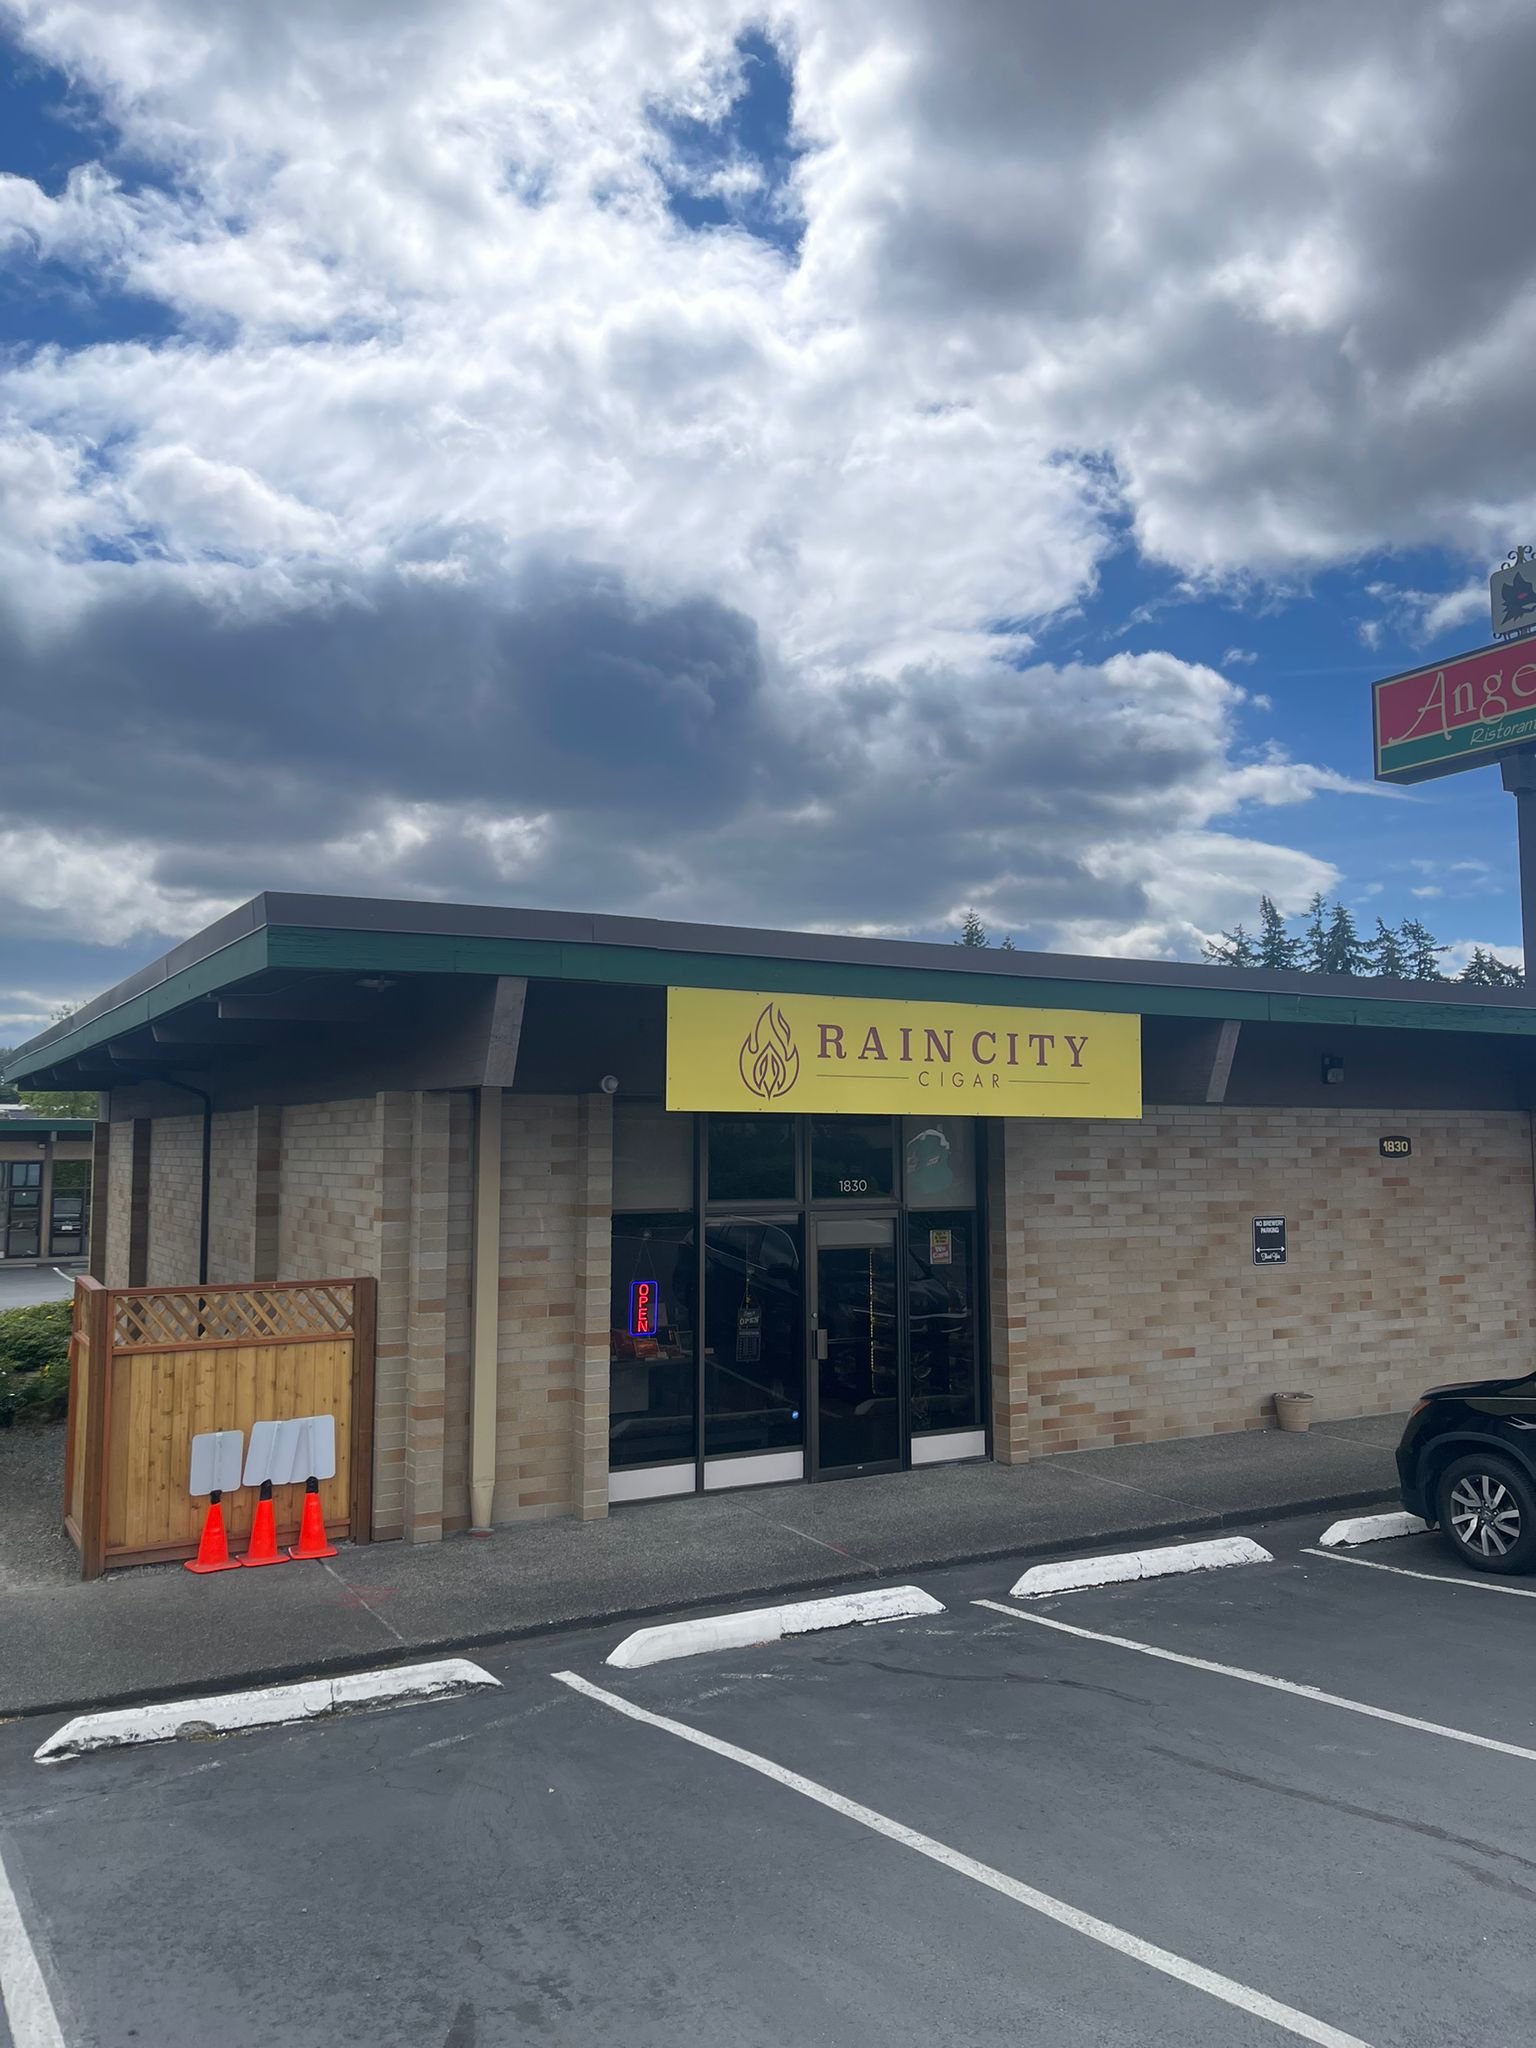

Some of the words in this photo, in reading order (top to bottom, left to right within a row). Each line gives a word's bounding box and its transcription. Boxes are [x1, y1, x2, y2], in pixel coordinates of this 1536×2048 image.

[817, 1024, 955, 1063] RAIN
[971, 1031, 1088, 1067] CITY
[918, 1071, 1001, 1089] CIGAR
[1383, 1141, 1408, 1152] 1830
[839, 1180, 867, 1192] 1830
[637, 1283, 649, 1332] OPEN
